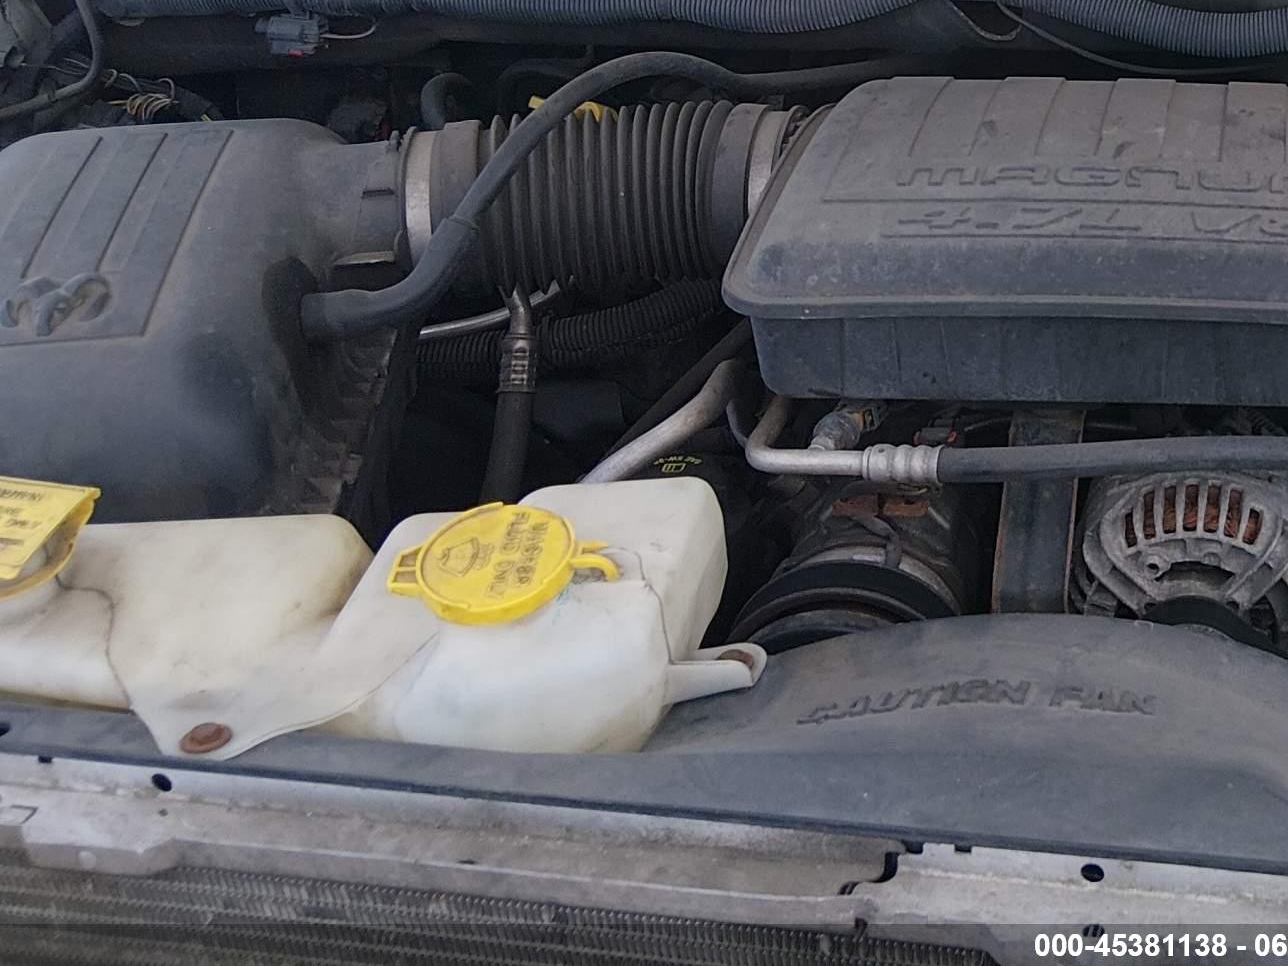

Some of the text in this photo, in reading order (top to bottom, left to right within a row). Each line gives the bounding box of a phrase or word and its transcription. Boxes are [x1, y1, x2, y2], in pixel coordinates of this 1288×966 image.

[898, 206, 1143, 231] 4.7L
[484, 511, 531, 600] FLUID ONLY
[796, 678, 1156, 724] CAUTION FAN
